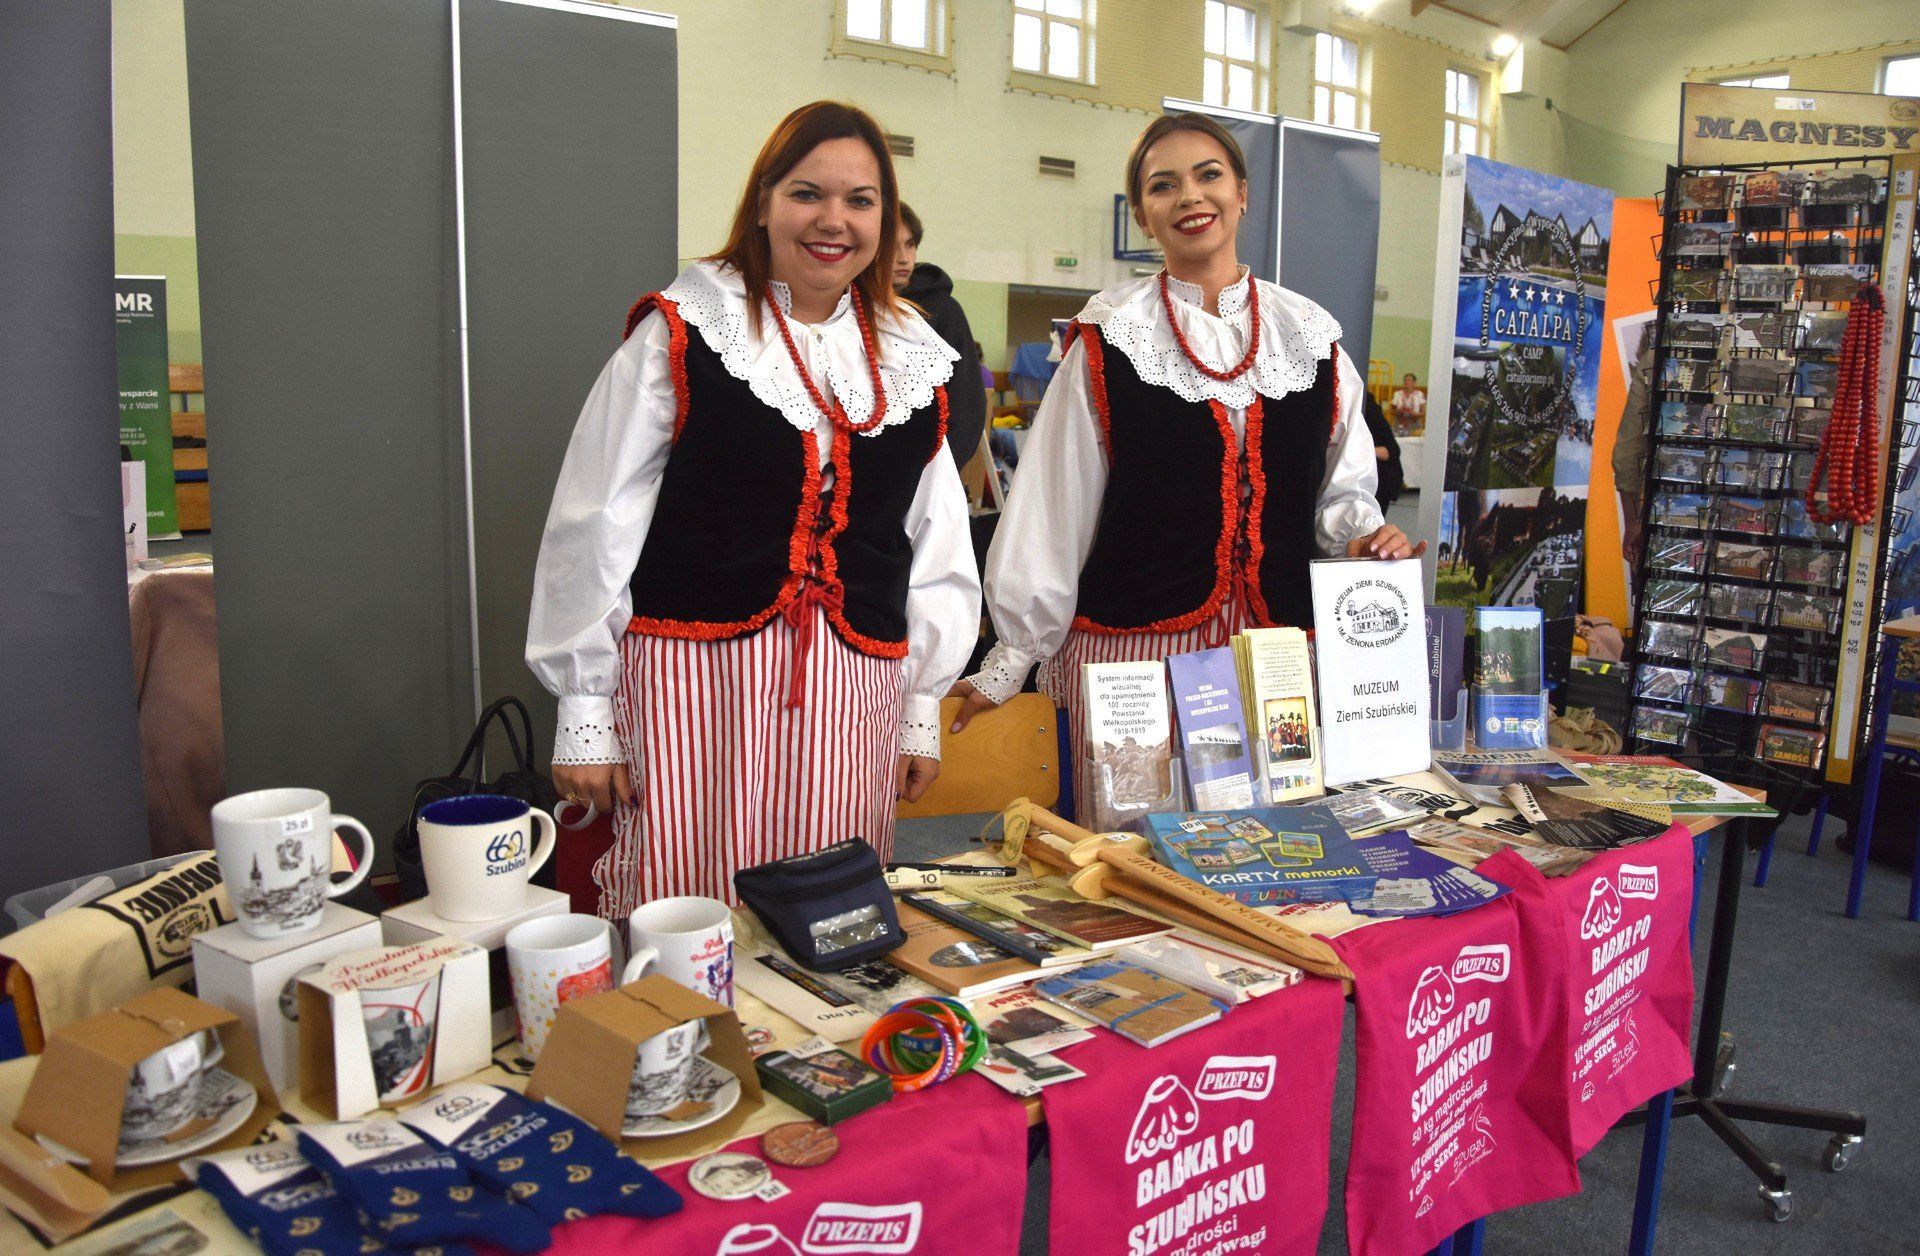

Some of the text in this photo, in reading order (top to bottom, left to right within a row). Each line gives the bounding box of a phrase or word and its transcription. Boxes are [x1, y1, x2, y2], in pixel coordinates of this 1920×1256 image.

[1695, 115, 1919, 149] MAGNESY
[1495, 309, 1572, 341] CATALPA
[1522, 346, 1544, 360] CAMP
[1505, 373, 1556, 388] catalpacamp.pl
[136, 401, 159, 410] Wami
[1335, 579, 1408, 615] MUZEUM ZIEMI SZUBIŃSKIEJ
[1337, 622, 1410, 648] IM. ZENONA ERDMANNA
[1097, 673, 1154, 684] System informacji
[1111, 684, 1142, 692] wizualnej
[1353, 680, 1400, 696] MUZEUM
[1111, 692, 1156, 701] upamiętnienia
[1122, 701, 1150, 709] rocznicy
[1336, 701, 1418, 723] Ziemi Szubińskiej
[1102, 719, 1156, 727] Wielkopolskiego
[1114, 727, 1146, 735] 1918-1919
[486, 858, 526, 876] Szubina
[1202, 866, 1362, 885] KARTY memorki
[920, 873, 937, 884] 10
[1621, 875, 1655, 891] PRZEPIS
[1242, 888, 1297, 902] SZUBIN
[1592, 914, 1651, 976] BABKA PO
[1456, 956, 1501, 975] PRZEPIS
[1584, 946, 1650, 1017] SZUBIŃSKU
[817, 1012, 844, 1021] Oto
[1415, 997, 1491, 1077] BABKA PO
[1572, 1070, 1577, 1083] 1
[1593, 1035, 1617, 1064] SERCE
[1202, 1070, 1265, 1091] PRZEPIS
[1411, 1031, 1493, 1123] SZUBIŃSKU
[1412, 1075, 1474, 1147] 50 kg mądrości
[1136, 1118, 1255, 1208] BABKA PO
[1409, 1188, 1414, 1202] 1
[1434, 1136, 1459, 1174] SERCE
[1127, 1163, 1267, 1256] SZUBIŃSKU
[811, 1219, 905, 1242] PRZEPIS
